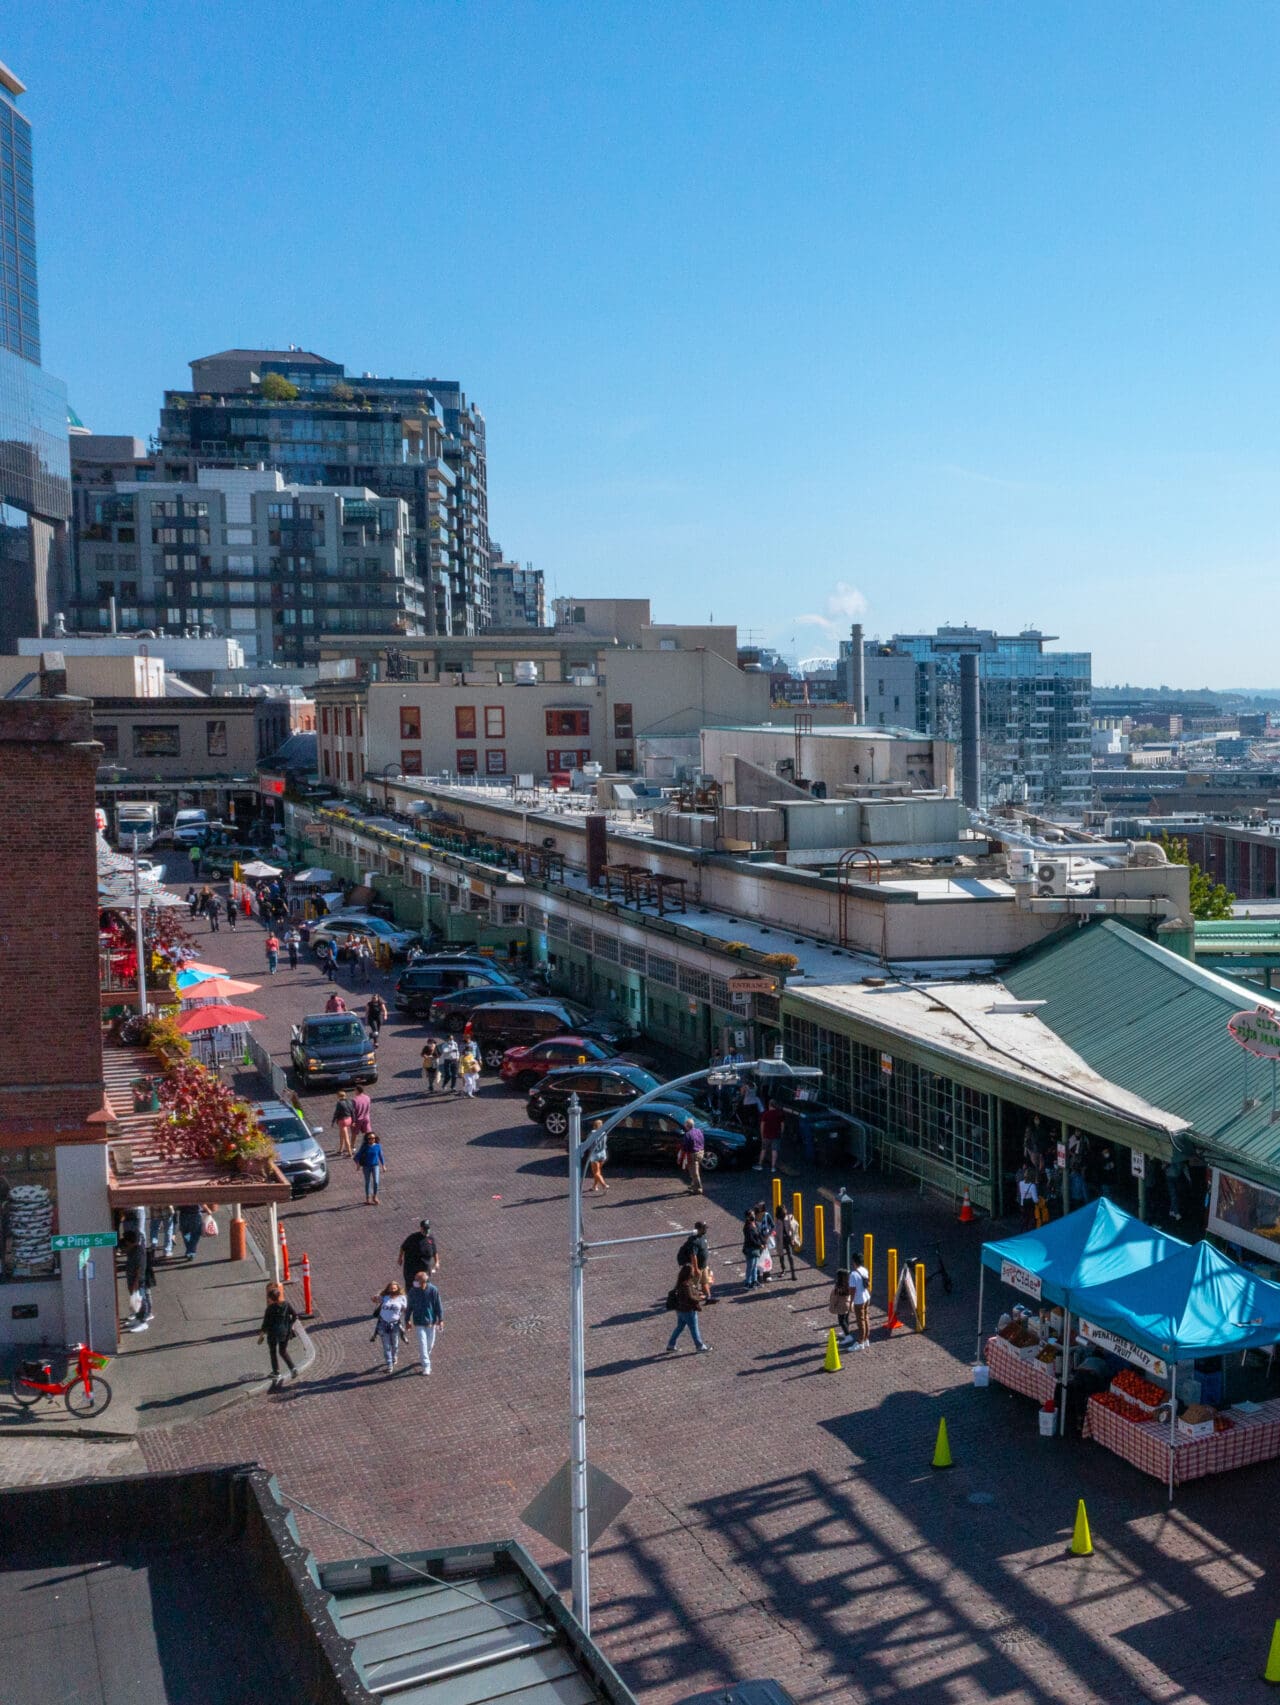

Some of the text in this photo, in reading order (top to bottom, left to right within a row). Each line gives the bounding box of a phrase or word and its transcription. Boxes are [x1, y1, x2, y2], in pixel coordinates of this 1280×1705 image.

[67, 1236, 103, 1246] Pine St
[1114, 1344, 1132, 1359] FRUIT
[1129, 1343, 1151, 1365] VALLEY
